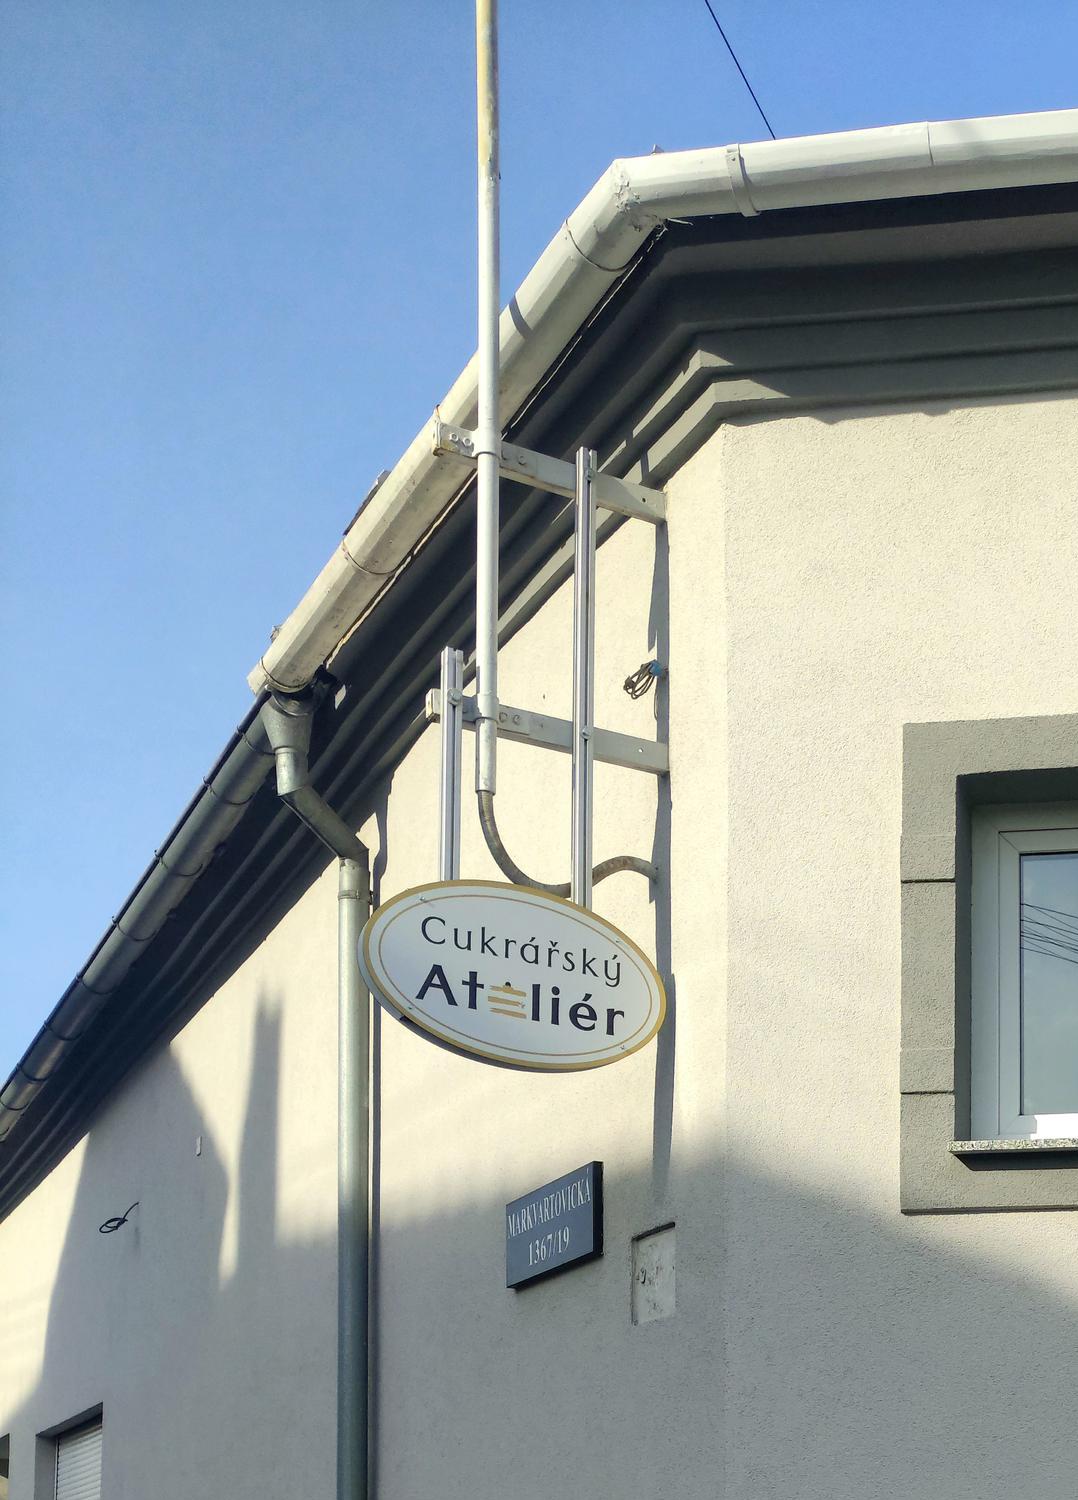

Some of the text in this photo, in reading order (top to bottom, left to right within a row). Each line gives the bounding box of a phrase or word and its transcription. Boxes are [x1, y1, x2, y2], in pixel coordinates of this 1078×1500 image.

[421, 916, 621, 987] Cukrářský
[507, 1168, 591, 1239] MARKVARTOVICKÁ
[528, 1226, 570, 1266] 1367/19
